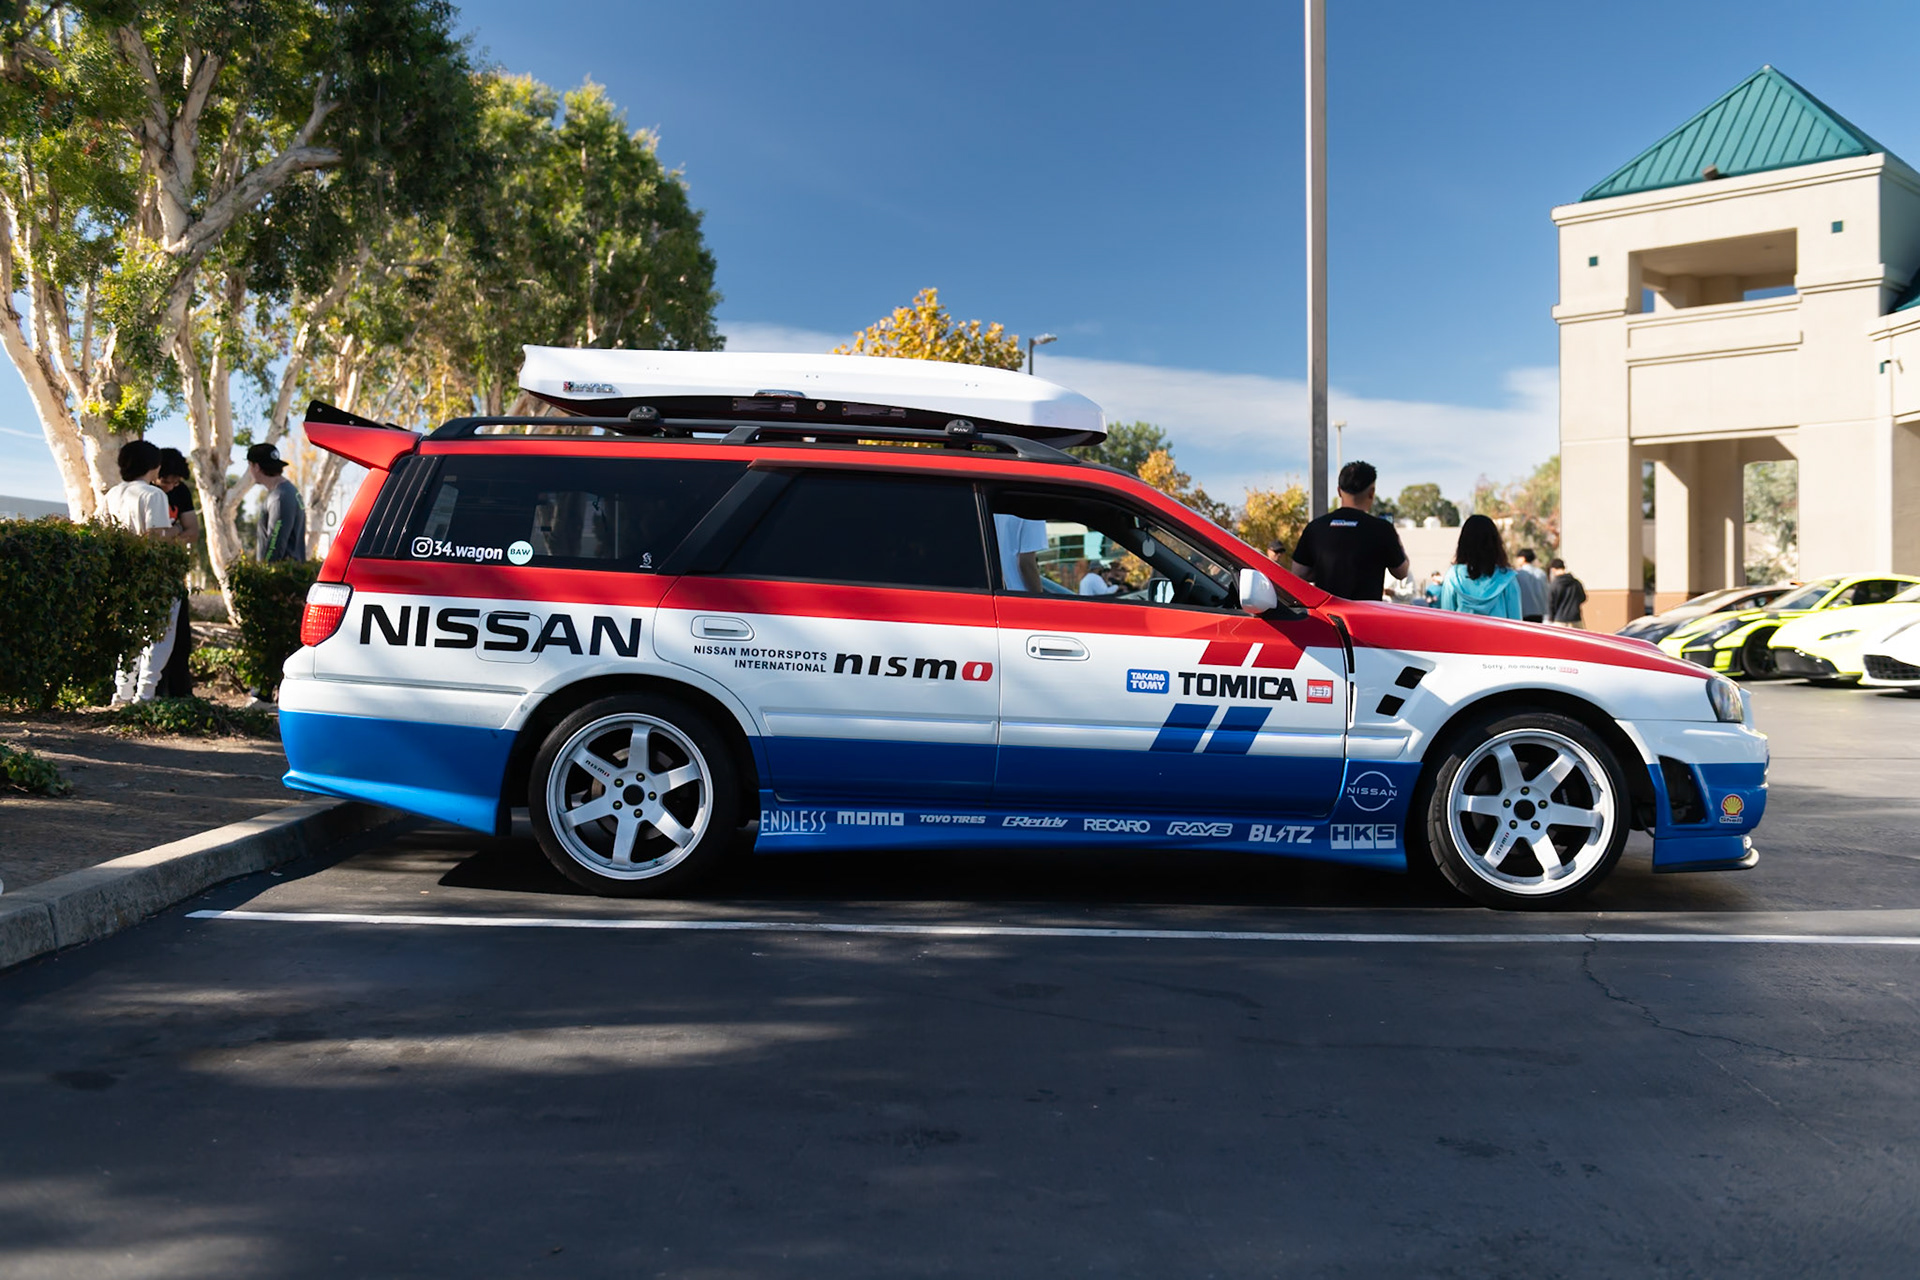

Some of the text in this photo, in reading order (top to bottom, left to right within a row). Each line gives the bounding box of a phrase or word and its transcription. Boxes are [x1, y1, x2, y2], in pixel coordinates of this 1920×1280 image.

[433, 541, 503, 562] 34.wagon
[510, 548, 531, 556] BAW
[359, 604, 642, 658] NISSAN
[694, 645, 827, 661] NISSAN MOTORSPOTS
[734, 659, 827, 673] INTERNATIONAL
[833, 652, 994, 682] nismo
[1130, 672, 1166, 681] TAKARA
[1130, 680, 1166, 690] TOMY
[1178, 671, 1298, 702] TOMICA
[1347, 786, 1398, 798] NISSAN
[761, 810, 827, 832] ENDLESS
[920, 814, 986, 824] TOYO TIRES
[1002, 816, 1069, 828] GReddy
[1083, 818, 1150, 833] RECARO
[1166, 821, 1233, 837] RAYS
[1248, 824, 1315, 844] BLITZ
[1330, 824, 1397, 850] HKS
